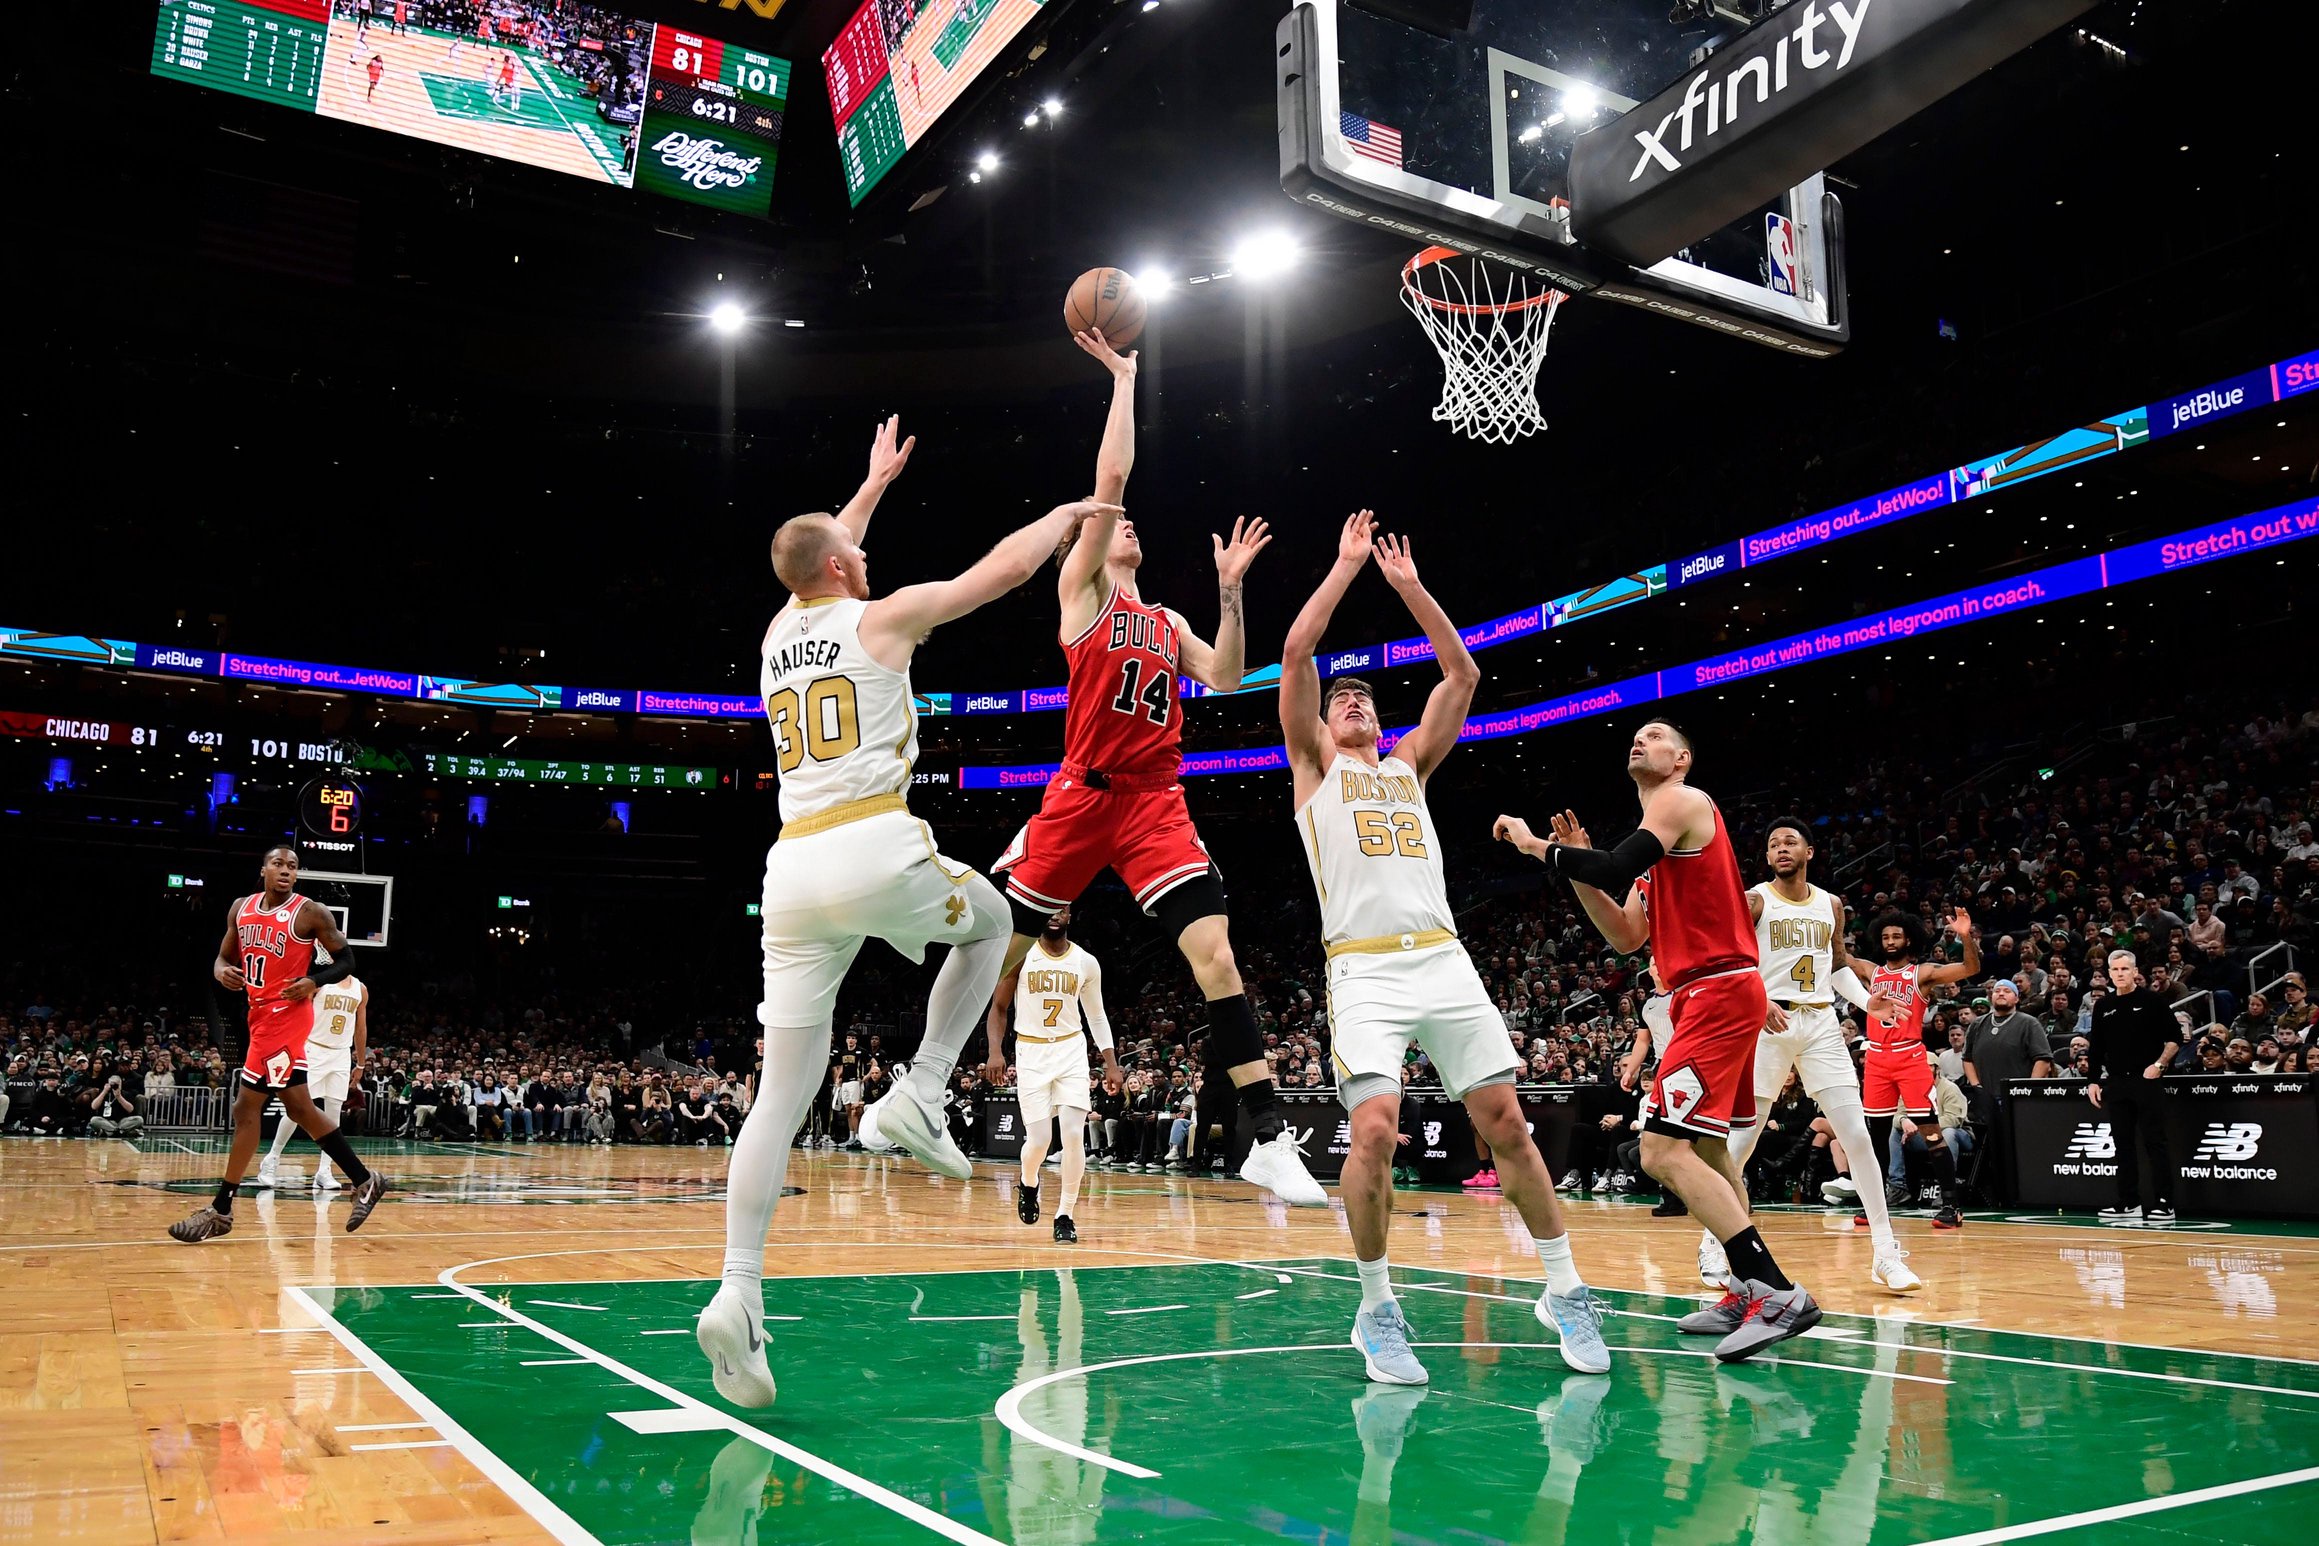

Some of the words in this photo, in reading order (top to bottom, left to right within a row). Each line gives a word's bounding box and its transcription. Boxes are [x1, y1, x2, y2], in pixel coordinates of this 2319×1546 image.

[187, 1, 216, 14] CELTICS
[242, 16, 255, 25] PTS
[288, 28, 303, 37] AST
[182, 35, 205, 48] WHITE
[675, 33, 703, 49] CHICAGO
[672, 47, 703, 75] 81
[745, 52, 770, 67] BOSTON
[736, 64, 778, 95] 101
[1629, 0, 1870, 183] xfinity
[692, 98, 736, 123] 6:21
[755, 116, 772, 129] 4th
[651, 132, 762, 174] Different
[661, 154, 747, 190] Here
[2173, 387, 2244, 429] jetBlue
[1681, 554, 1725, 583] jetBlue
[1749, 520, 1830, 557] Stretching
[2161, 527, 2246, 564] Stretch
[2251, 515, 2292, 541] out
[1108, 610, 1177, 669] BULL
[1695, 655, 1749, 683] Stretch
[1751, 649, 1776, 669] out
[1778, 640, 1813, 662] with
[1814, 634, 1841, 652] the
[1844, 621, 1886, 645] most
[1888, 604, 1961, 635] legroom
[1963, 598, 1980, 616] in
[1982, 580, 2045, 610] coach.
[152, 650, 202, 668] jetBlue
[229, 658, 311, 682] Stretching
[770, 640, 841, 682] HAUSER
[1330, 653, 1370, 674] jetBlue
[1392, 642, 1433, 660] Stretc
[576, 691, 621, 707] jetBlue
[645, 695, 719, 714] Stretching
[966, 696, 1008, 712] jetBlue
[1030, 692, 1068, 706] Stretc
[1112, 658, 1171, 727] 14
[768, 674, 861, 775] 30
[1460, 724, 1482, 738] the
[1486, 720, 1519, 733] most
[1520, 705, 1567, 729] legroom
[1569, 701, 1580, 714] in
[1581, 690, 1622, 712] coach.
[46, 718, 110, 741] CHICAGO
[130, 727, 157, 746] 81
[188, 731, 223, 746] 6:21
[251, 739, 288, 759] 101
[298, 743, 343, 764] BOSTO
[200, 745, 213, 753] 4th
[428, 763, 434, 772] 2
[449, 765, 456, 774] 3
[468, 767, 486, 776] 39.4
[497, 768, 525, 778] 37/94
[540, 770, 567, 780] 17/47
[582, 772, 589, 781] 5
[606, 773, 613, 782] 6
[630, 774, 640, 783] 17
[654, 775, 665, 784] 51
[999, 770, 1048, 785] Stretch
[1177, 759, 1222, 776] groom
[1224, 756, 1237, 768] in
[1239, 752, 1282, 768] coach.
[911, 774, 928, 784] :25
[932, 774, 949, 784] PM
[1341, 770, 1422, 809] BOSTON
[320, 788, 354, 807] 6:20
[331, 805, 349, 832] 6
[316, 841, 355, 852] TISSOT
[1353, 810, 1428, 860] 52
[1769, 918, 1832, 953] BOSTON
[244, 953, 266, 988] 11
[1028, 969, 1079, 997] BOSTON
[1790, 954, 1816, 993] 4
[323, 994, 359, 1014] BOSTON
[1042, 999, 1064, 1027] 7
[330, 1015, 347, 1035] 9
[2009, 1086, 2032, 1096] xfinity
[2043, 1086, 2067, 1096] xfinity
[2192, 1084, 2218, 1095] xfinity
[2232, 1083, 2259, 1094] xfinity
[2273, 1082, 2302, 1094] xfinity
[1328, 1146, 1340, 1154] new
[2053, 1163, 2080, 1175] new
[2181, 1166, 2211, 1178] new
[2214, 1164, 2278, 1180] balance
[1917, 1184, 1941, 1202] jetB
